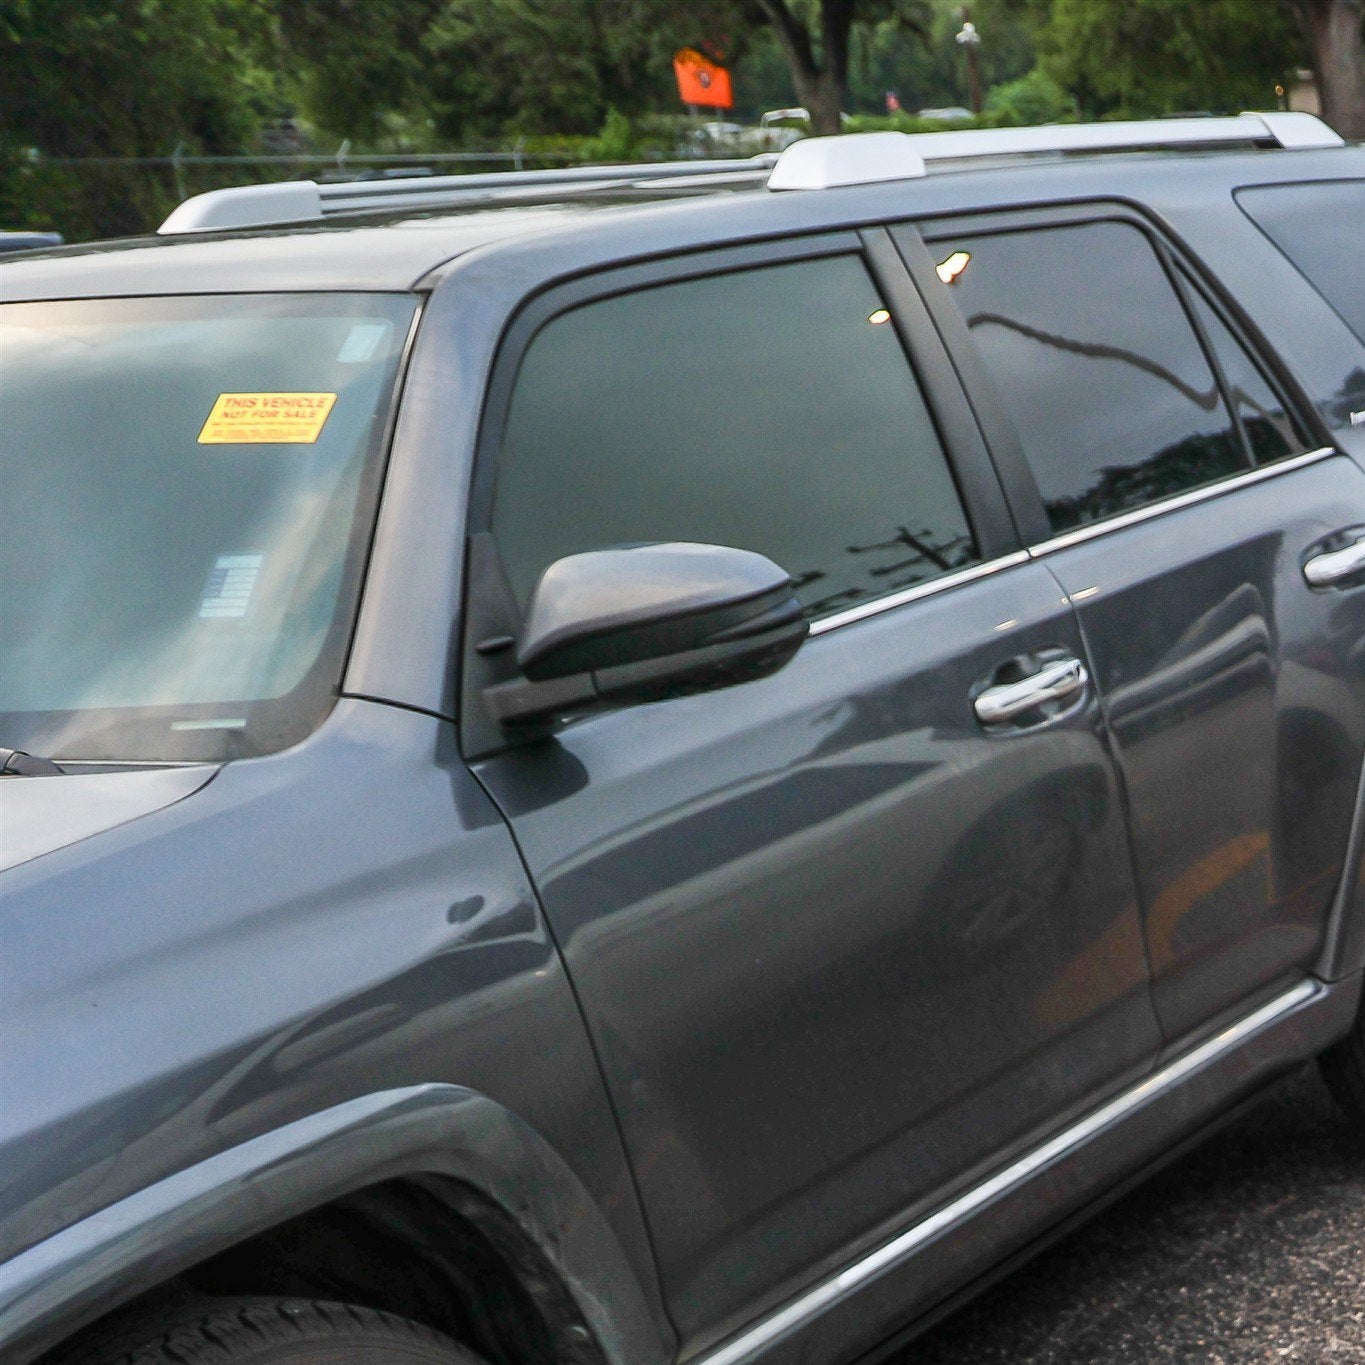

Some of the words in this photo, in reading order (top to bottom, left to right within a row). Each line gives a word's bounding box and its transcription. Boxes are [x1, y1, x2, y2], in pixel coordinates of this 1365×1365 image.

[225, 398, 257, 408] THIS
[262, 398, 326, 408] VEHICLE
[221, 410, 247, 419] NOT
[251, 410, 279, 418] FOR
[283, 410, 317, 418] SALE
